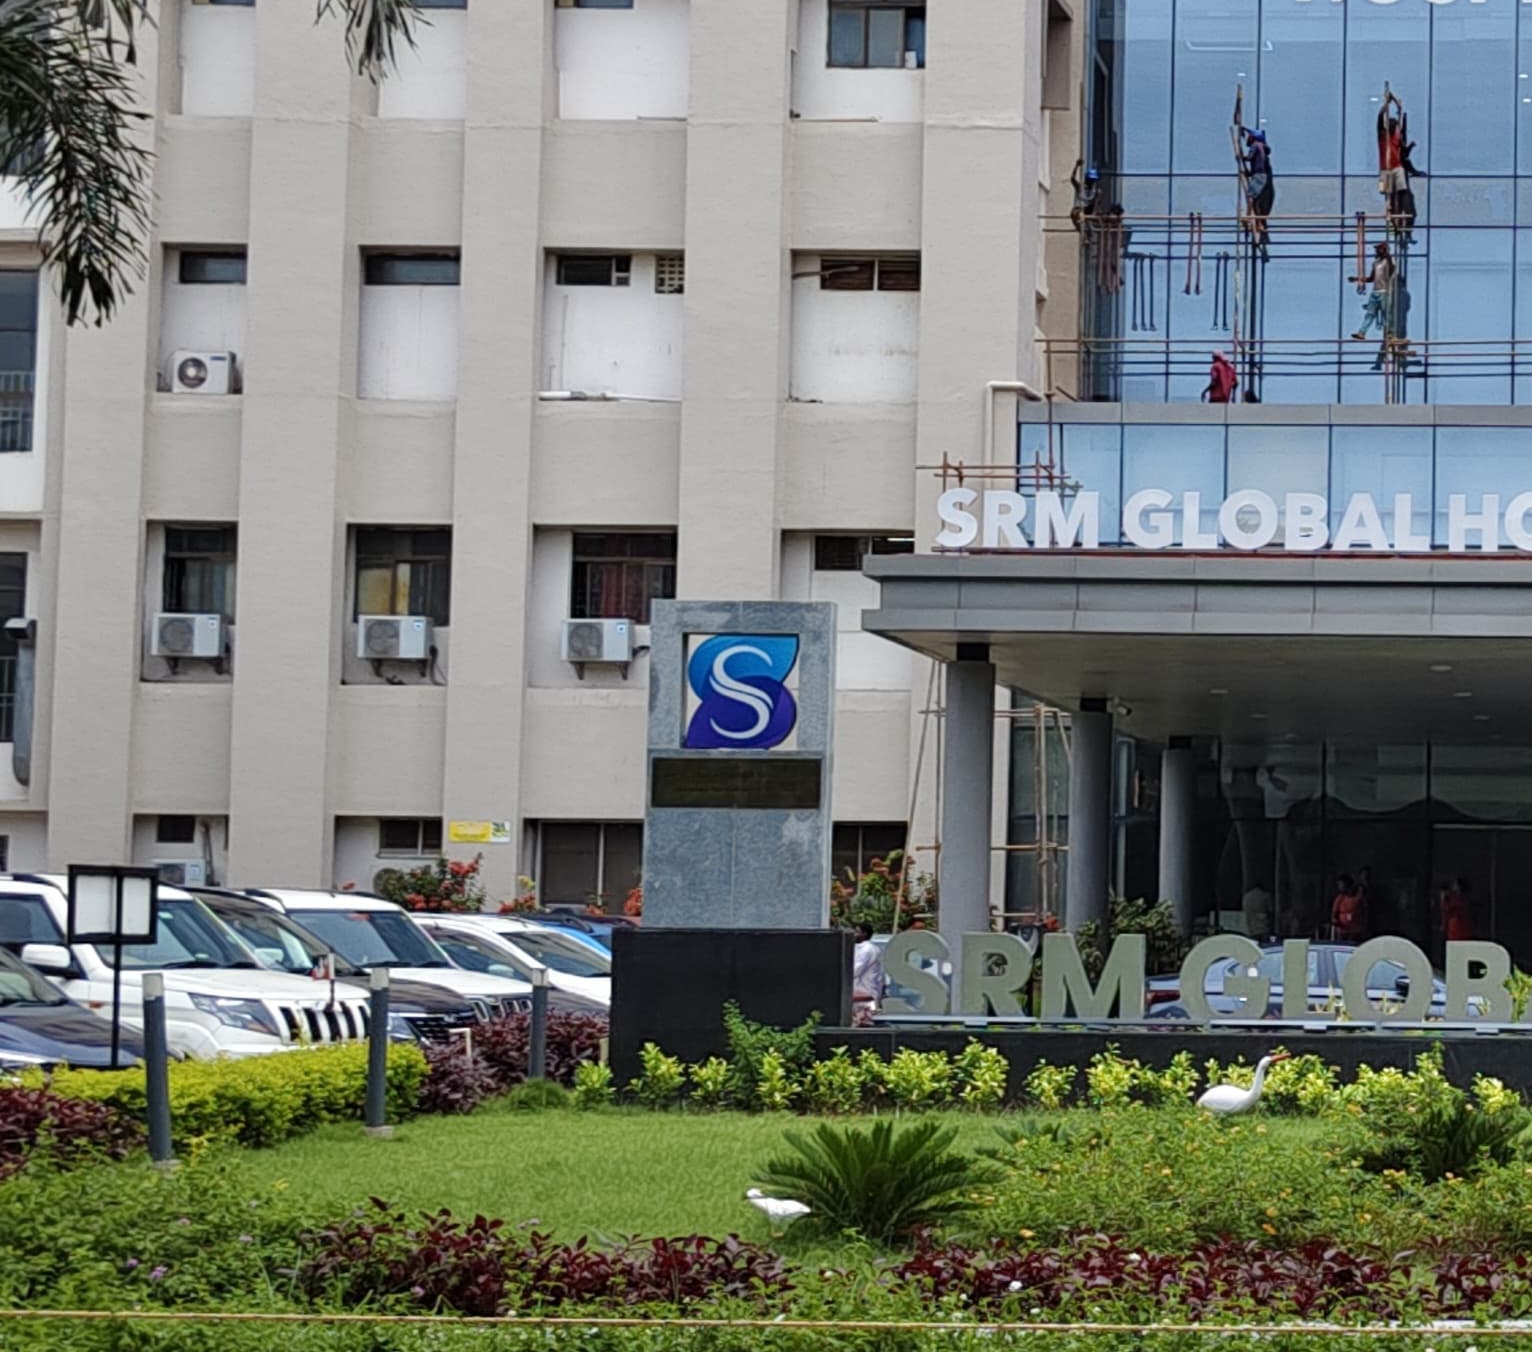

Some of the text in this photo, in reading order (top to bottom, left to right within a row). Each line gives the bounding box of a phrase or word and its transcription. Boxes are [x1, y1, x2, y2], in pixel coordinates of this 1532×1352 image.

[935, 489, 1099, 549] SRM
[1122, 489, 1433, 552] GLOBAL
[881, 930, 1147, 1021] SRM
